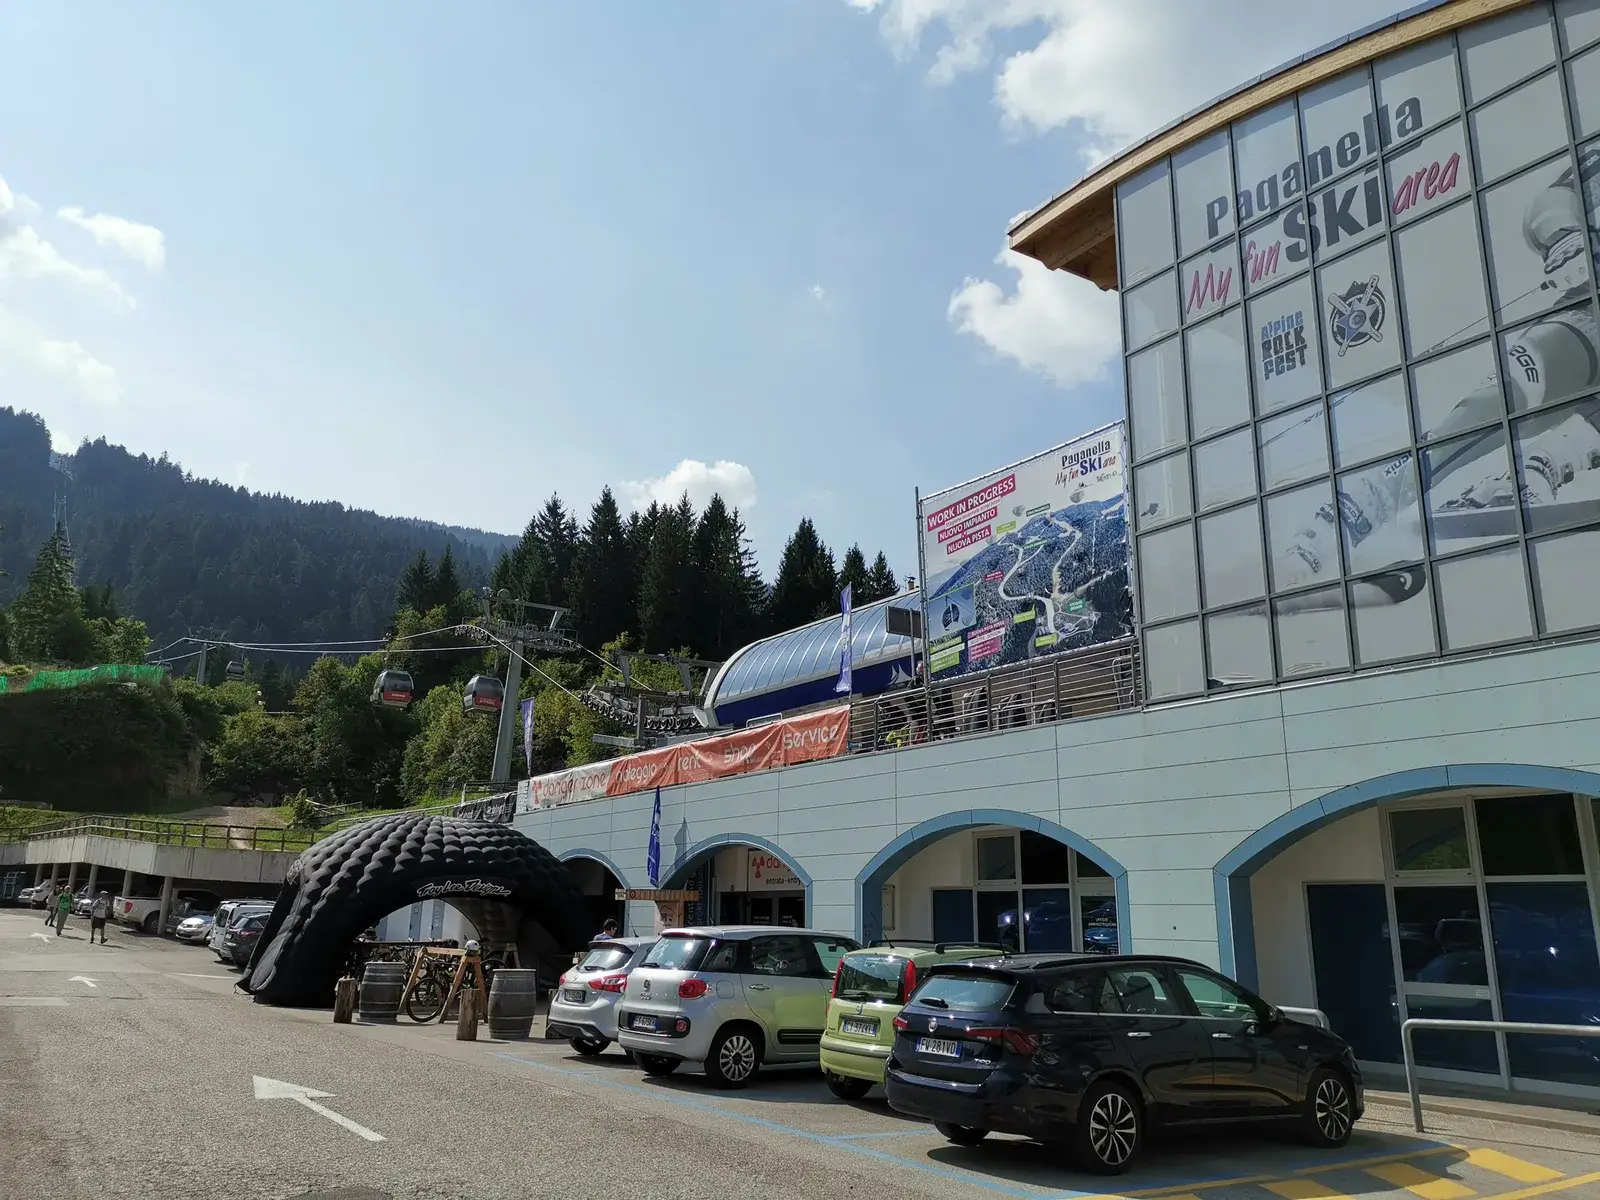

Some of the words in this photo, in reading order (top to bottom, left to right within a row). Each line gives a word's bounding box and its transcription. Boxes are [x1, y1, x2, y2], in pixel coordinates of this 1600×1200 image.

[1206, 96, 1423, 240] Paganella
[1186, 263, 1233, 315] My
[1242, 240, 1281, 284] fun
[1283, 175, 1383, 263] SKI
[1392, 152, 1460, 215] area
[1061, 440, 1111, 468] Paganella
[1055, 472, 1067, 489] My
[1080, 456, 1102, 476] SKI
[1102, 455, 1116, 469] area
[927, 505, 956, 528] WORK
[956, 500, 966, 516] IN
[967, 477, 1014, 510] PROGRESS
[938, 523, 962, 542] NUOVO
[963, 508, 996, 531] IMPIANTO
[946, 535, 972, 553] NUOVA
[971, 528, 991, 544] PISTA
[541, 777, 579, 802] danger
[581, 772, 606, 791] zone
[783, 723, 840, 750] service
[416, 881, 443, 898] Troy
[441, 880, 464, 894] Lee
[463, 878, 512, 898] Designs
